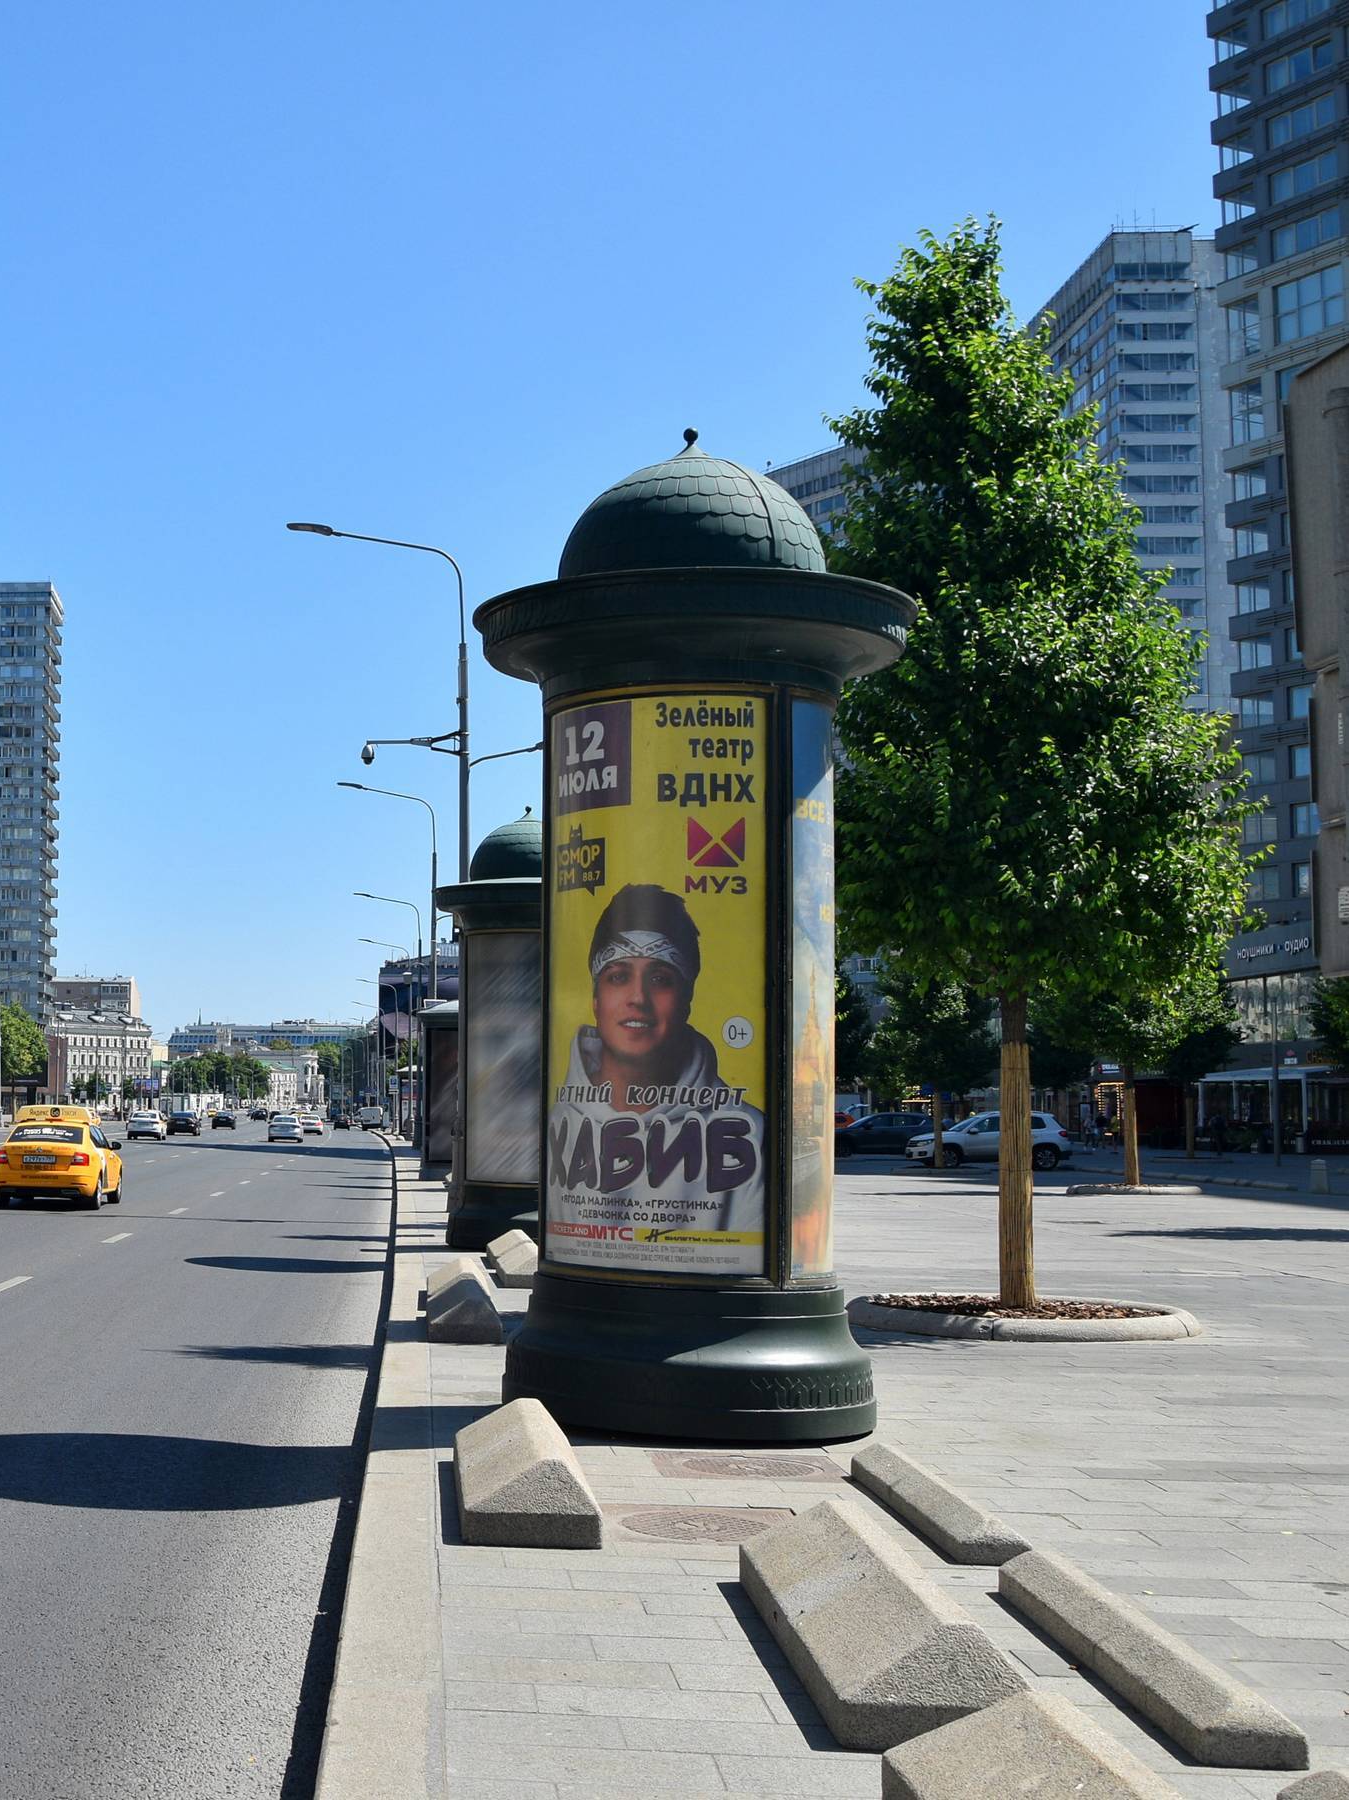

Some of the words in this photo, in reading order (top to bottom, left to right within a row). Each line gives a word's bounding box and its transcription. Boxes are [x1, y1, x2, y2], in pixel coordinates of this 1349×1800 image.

[655, 700, 754, 728] Зелёный
[565, 721, 605, 766] 12
[689, 737, 754, 766] театр
[657, 773, 756, 807] ВДНХ
[583, 870, 601, 882] 88.7
[685, 875, 748, 895] МУЗ
[1236, 944, 1274, 961] наушники
[1284, 937, 1309, 955] аудио
[728, 1025, 748, 1040] 0+
[626, 1084, 748, 1110] концерт
[550, 1116, 758, 1194] ХАБИБ
[633, 1212, 649, 1221] СО
